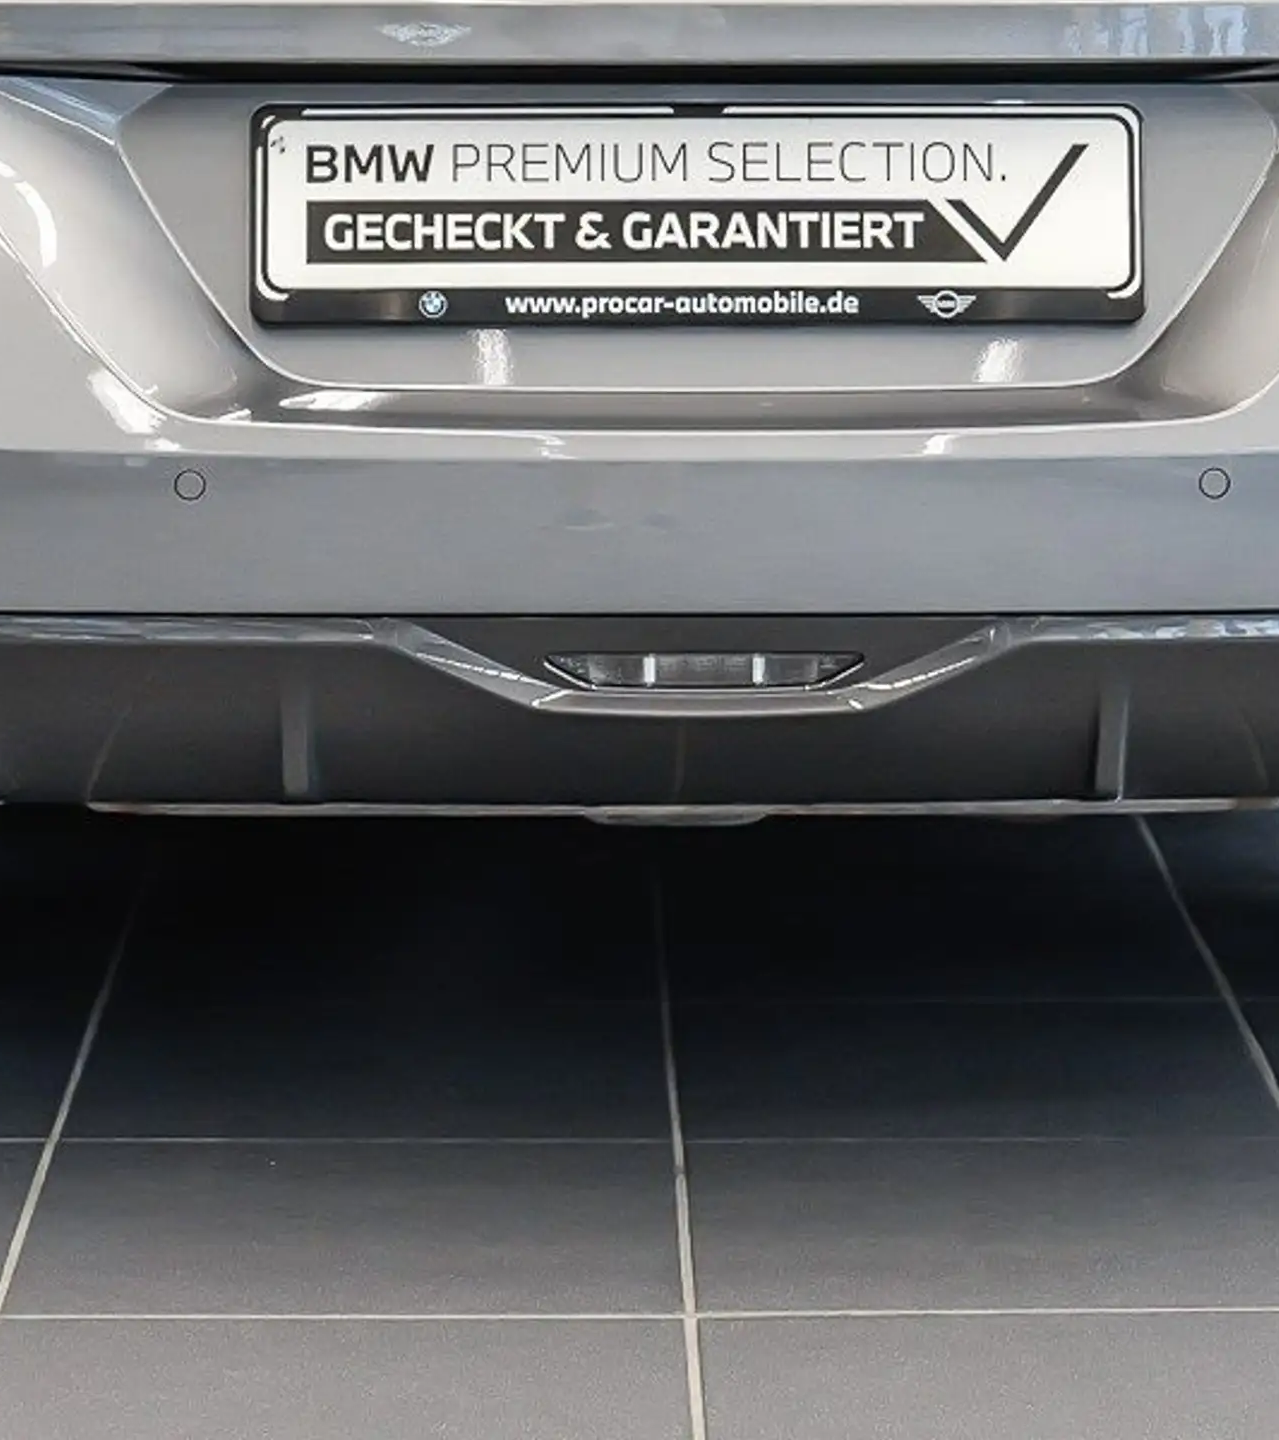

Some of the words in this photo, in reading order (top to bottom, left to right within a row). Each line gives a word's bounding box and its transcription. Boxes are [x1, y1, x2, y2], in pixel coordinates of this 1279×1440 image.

[306, 144, 434, 183] BMW
[452, 142, 688, 183] PREMIUM
[707, 142, 1008, 183] SELECTION.
[324, 213, 566, 251] GECHECKT
[575, 212, 612, 250] &
[622, 211, 925, 250] GARANTIERT
[505, 292, 860, 318] www.procar-automobile.de
